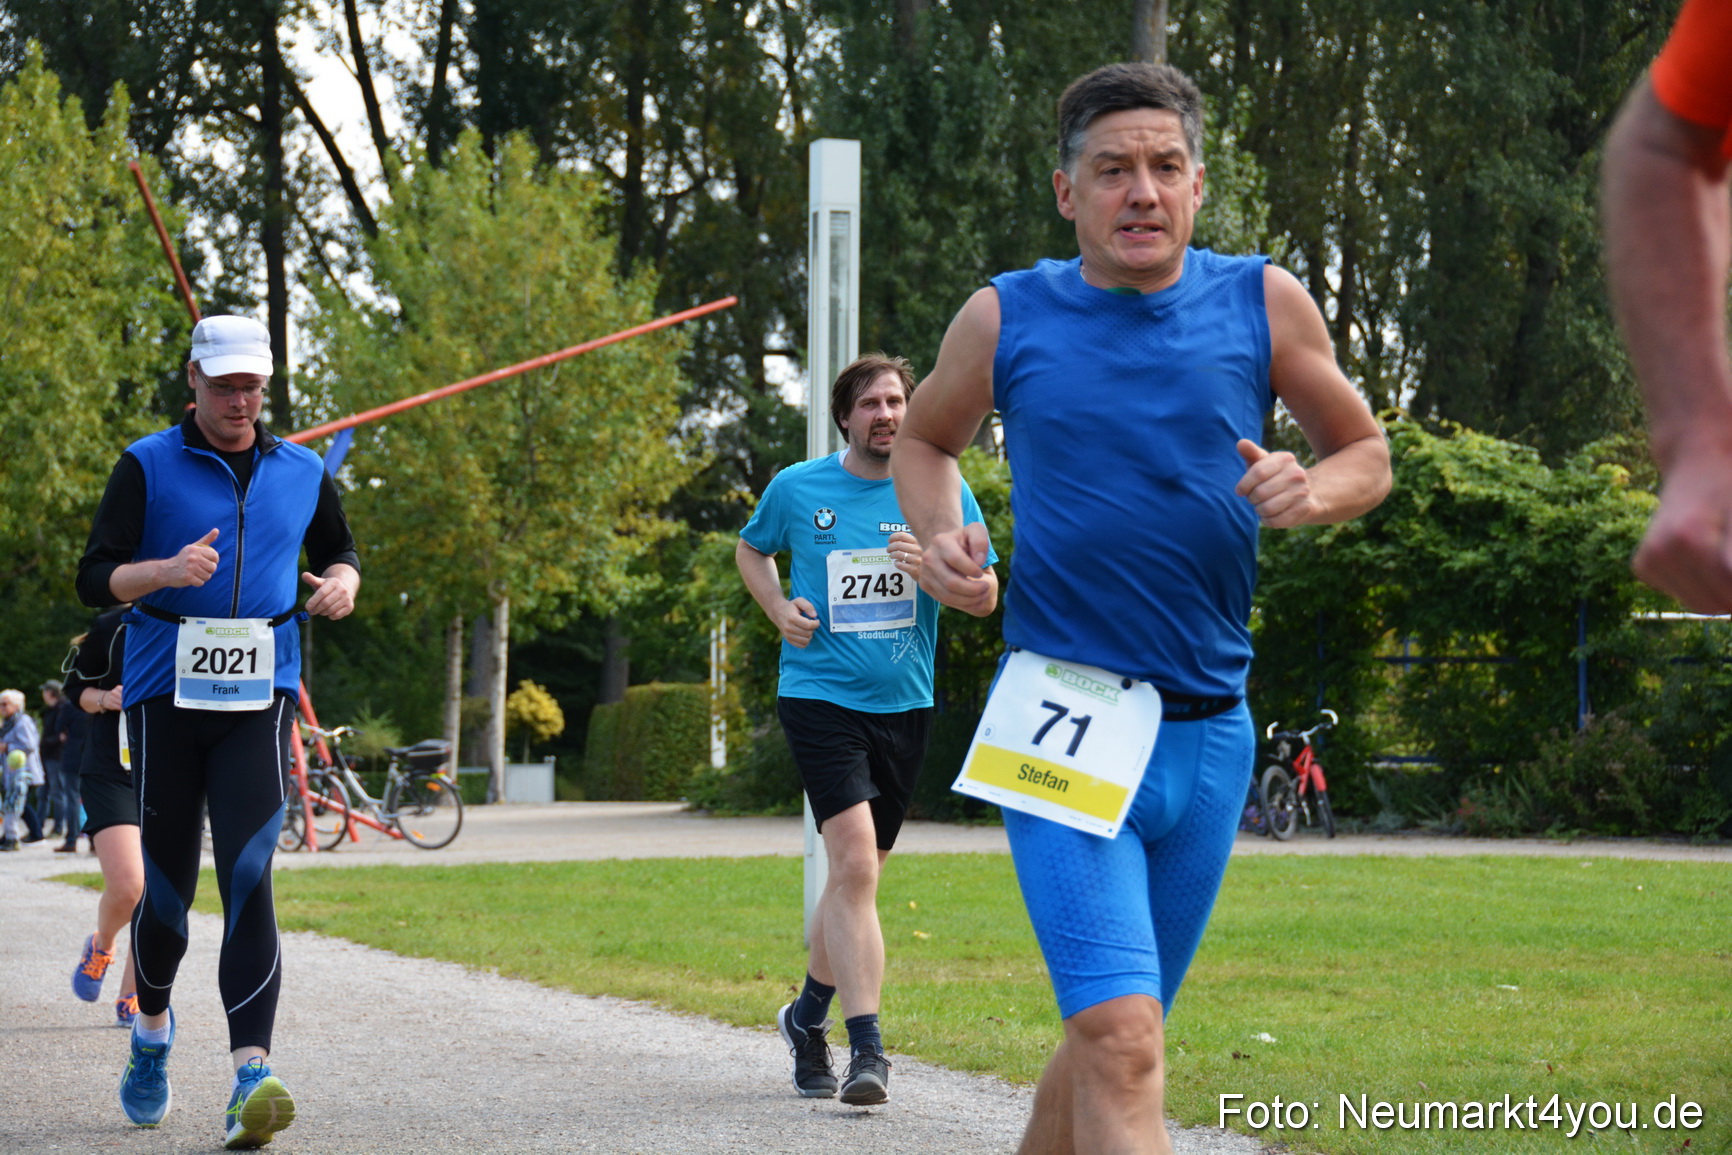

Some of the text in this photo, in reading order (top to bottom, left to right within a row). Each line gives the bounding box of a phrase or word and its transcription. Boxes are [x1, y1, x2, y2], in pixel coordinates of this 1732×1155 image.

[879, 521, 912, 532] BOC
[861, 556, 892, 564] BOCK
[841, 572, 904, 600] 2743
[215, 627, 250, 636] BOCK
[857, 630, 899, 641] Stadtlauf
[191, 646, 257, 675] 2021
[212, 684, 240, 694] Frank
[1061, 669, 1122, 702] BOCK
[1031, 699, 1093, 757] 71
[1017, 763, 1070, 793] Stefan
